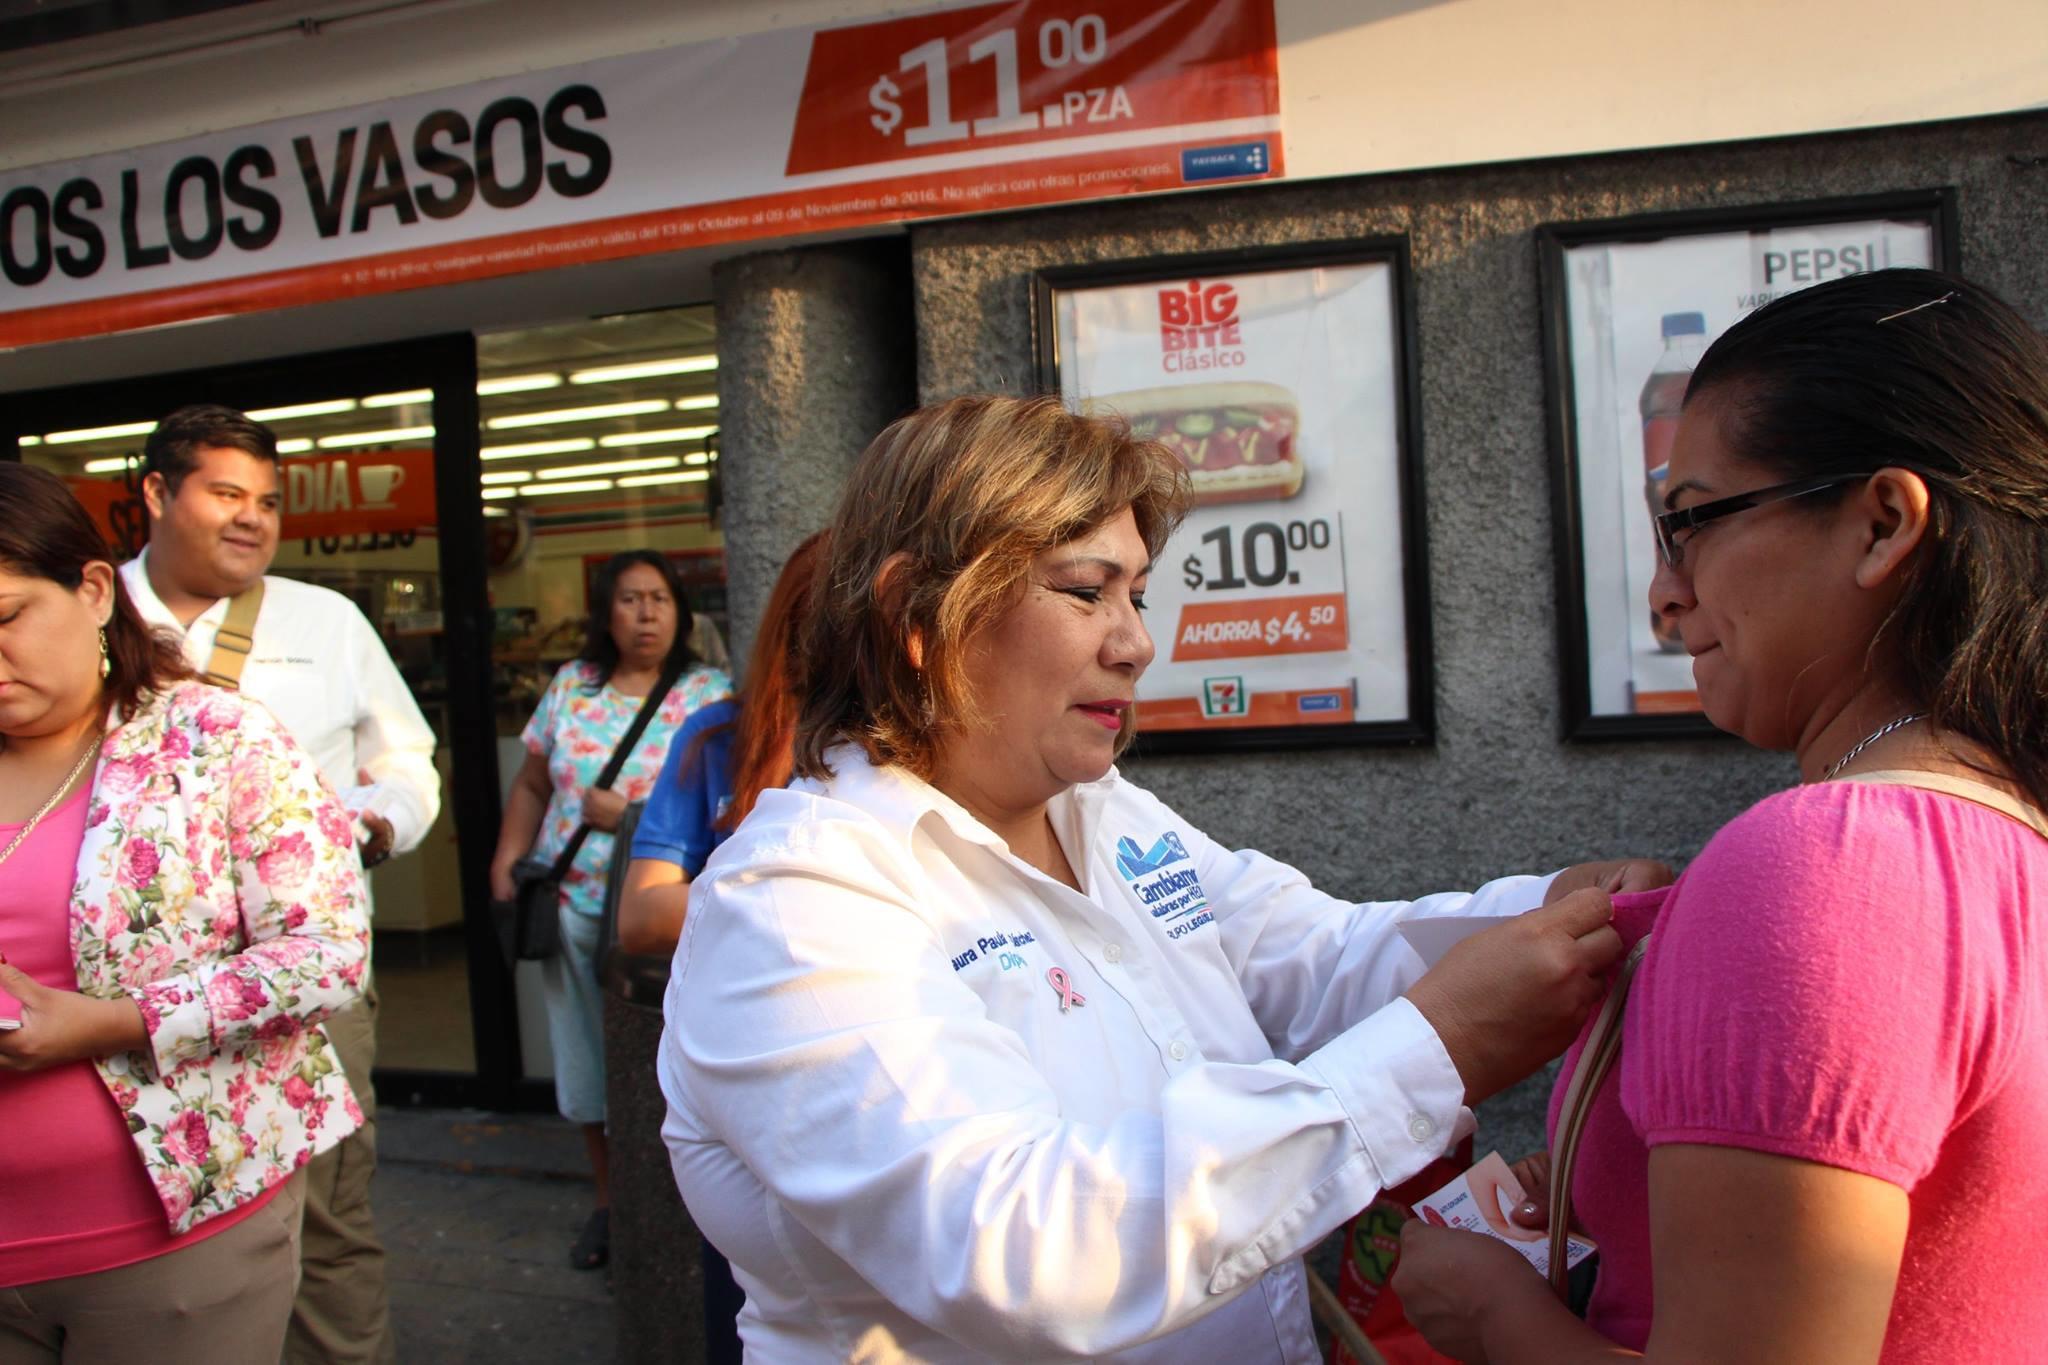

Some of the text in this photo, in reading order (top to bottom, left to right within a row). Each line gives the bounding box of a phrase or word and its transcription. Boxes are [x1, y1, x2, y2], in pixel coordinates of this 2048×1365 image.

[1063, 85, 1134, 127] PZA
[0, 84, 612, 287] OS LOS VASOS
[679, 221, 694, 235] de
[698, 213, 748, 232] Octubre
[751, 211, 764, 225] al
[786, 206, 801, 220] de
[806, 196, 876, 217] Noviembre
[879, 193, 896, 208] de
[942, 185, 963, 199] No
[966, 181, 1007, 200] aplica
[1009, 179, 1038, 192] con
[1040, 173, 1074, 189] otras
[1078, 162, 1172, 187] promociones.
[1764, 244, 1875, 285] PEPSI
[1163, 349, 1245, 373] Clásico
[1181, 620, 1263, 645] AHORRA
